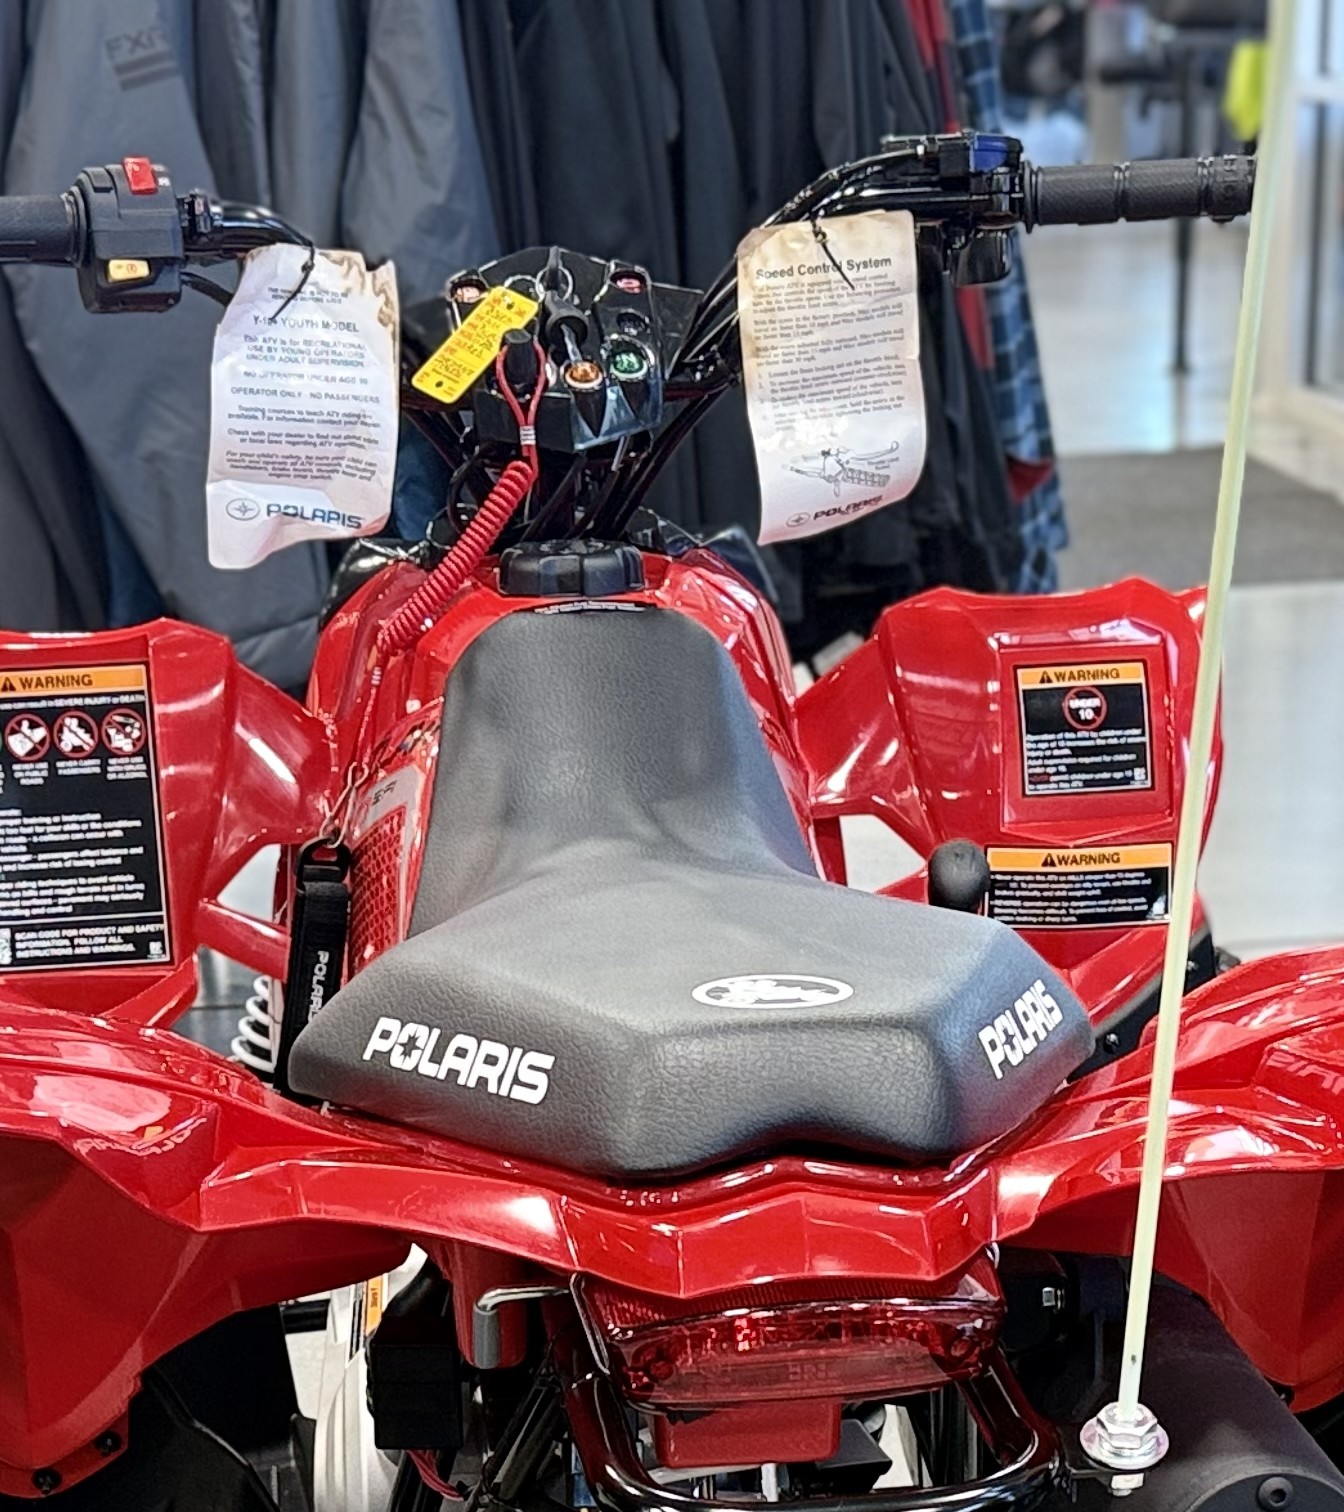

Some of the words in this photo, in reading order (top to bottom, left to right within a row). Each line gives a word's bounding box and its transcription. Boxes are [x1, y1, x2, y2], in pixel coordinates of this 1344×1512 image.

[756, 265, 794, 280] Speed
[797, 262, 843, 277] Control
[846, 256, 892, 273] System
[281, 318, 318, 329] YOUTH
[322, 320, 359, 332] MODEL
[266, 502, 363, 530] POLARIS
[18, 673, 94, 691] WARNING
[1054, 668, 1120, 683] WARNING
[1068, 698, 1101, 709] UNDER
[1078, 708, 1094, 721] 10
[1057, 851, 1121, 866] WARNING
[978, 979, 1063, 1080] POLARIS
[362, 1016, 556, 1105] POLARIS
